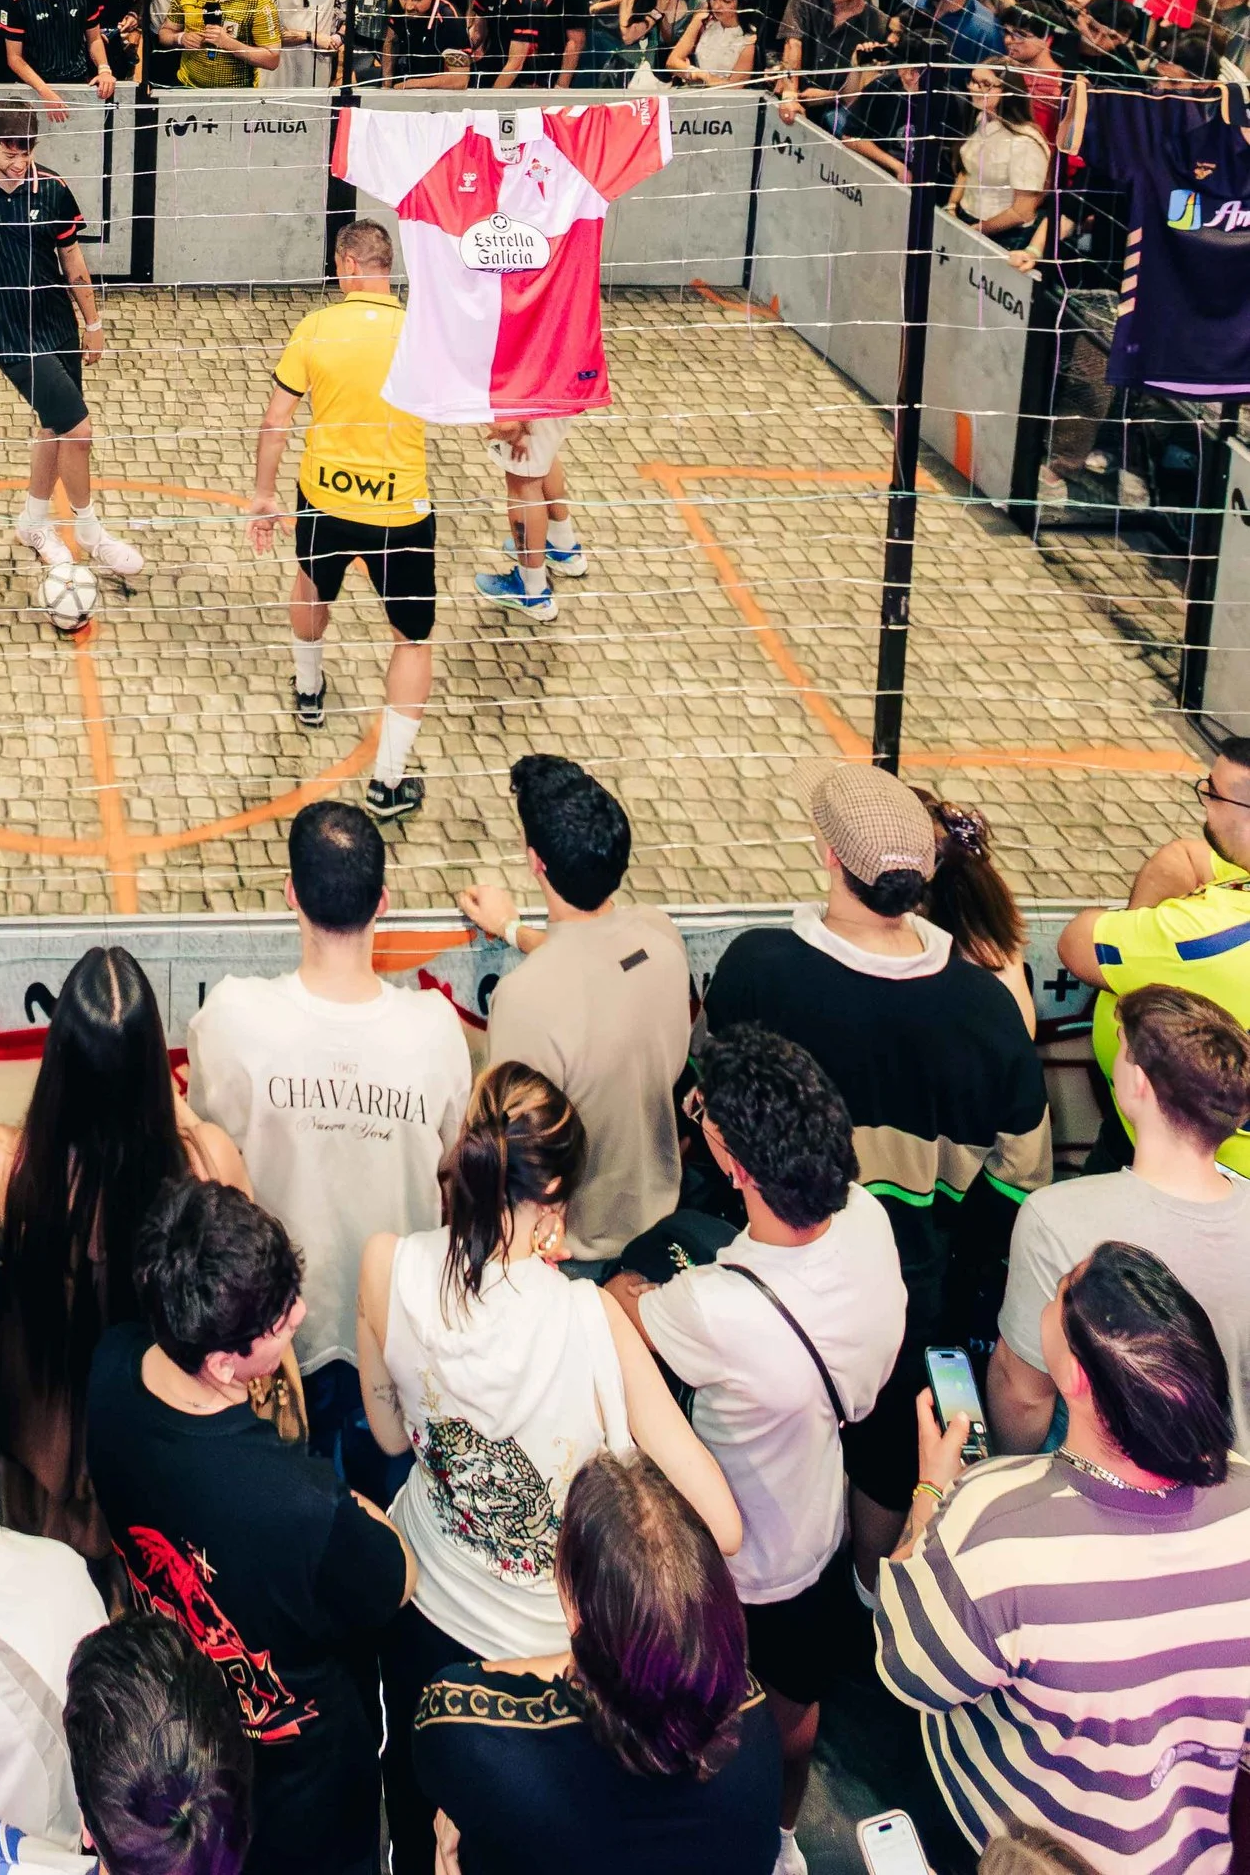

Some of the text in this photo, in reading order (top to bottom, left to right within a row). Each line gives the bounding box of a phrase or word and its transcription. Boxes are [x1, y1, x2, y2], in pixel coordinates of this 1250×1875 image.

[243, 118, 308, 134] LALIGA
[670, 120, 733, 135] LALIGA
[474, 233, 534, 247] Estrella
[478, 248, 533, 265] Galicia
[968, 267, 1025, 321] LALIGA
[268, 1075, 427, 1125] CHAVARRÍA
